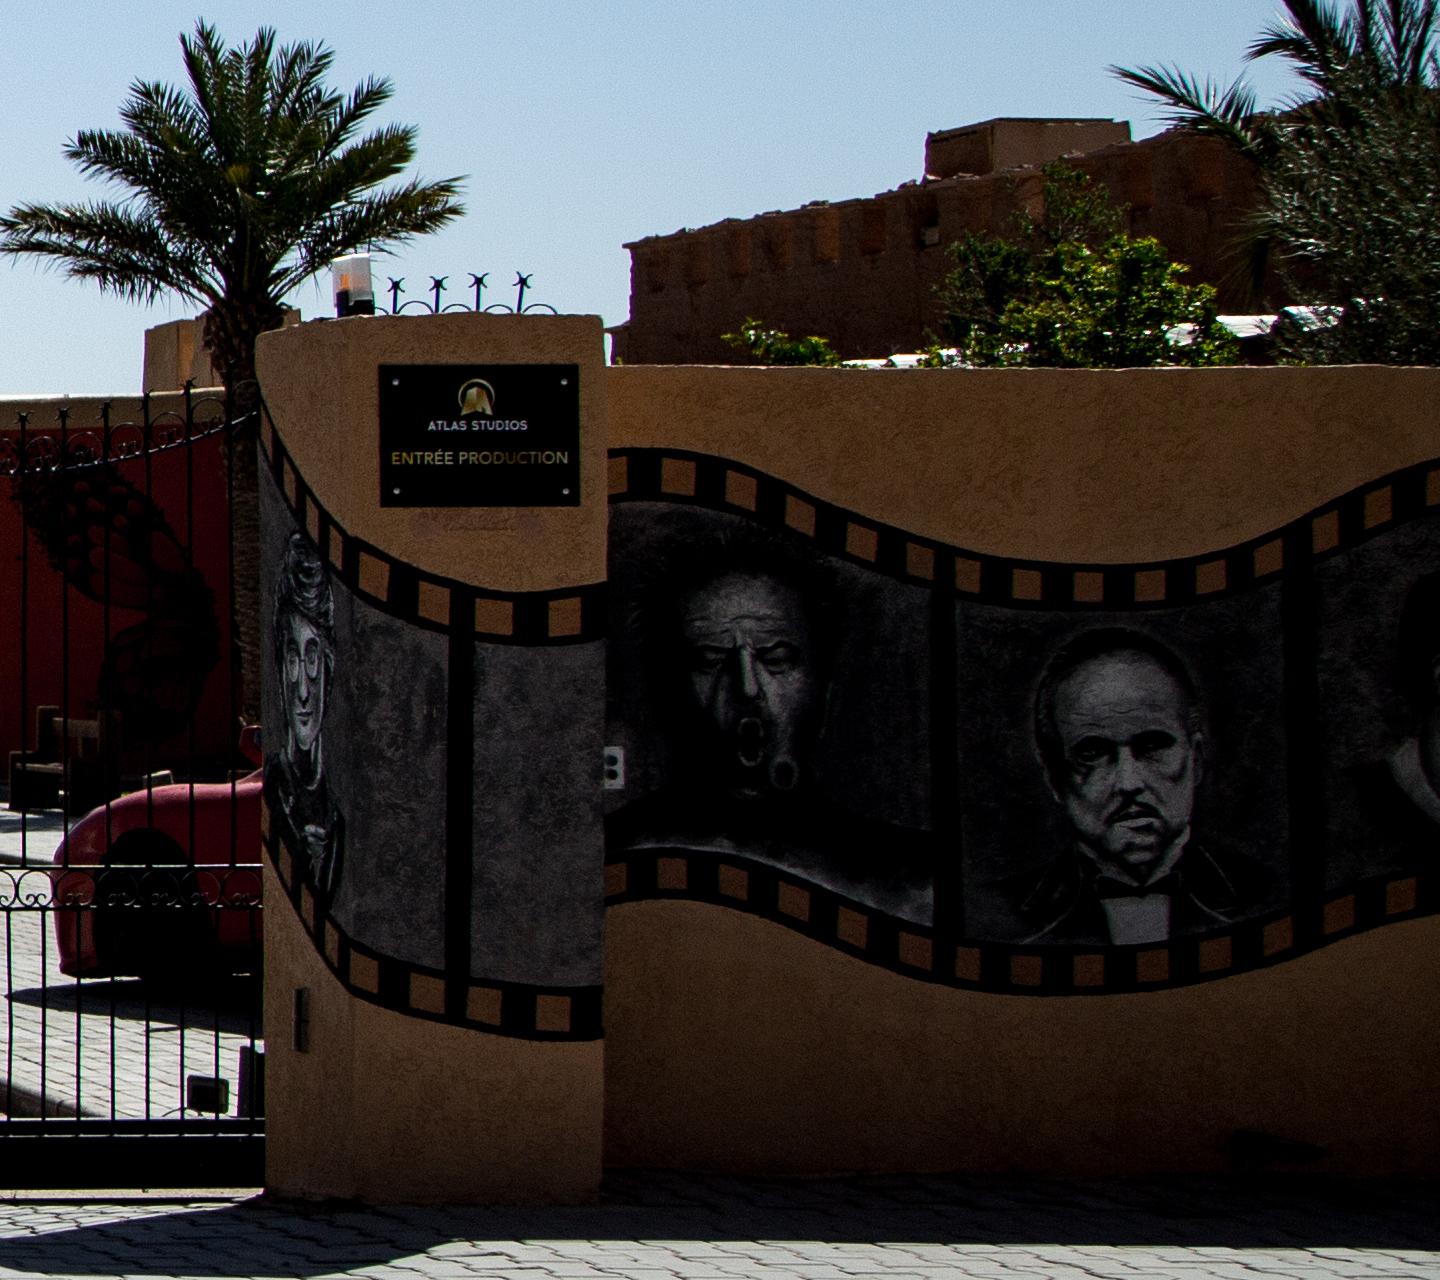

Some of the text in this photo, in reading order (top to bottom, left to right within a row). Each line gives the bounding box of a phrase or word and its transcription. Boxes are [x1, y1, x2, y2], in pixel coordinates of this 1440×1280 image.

[428, 420, 528, 431] ATLAS STUDIOS
[392, 449, 568, 465] ENTRÉE PRODUCTION
